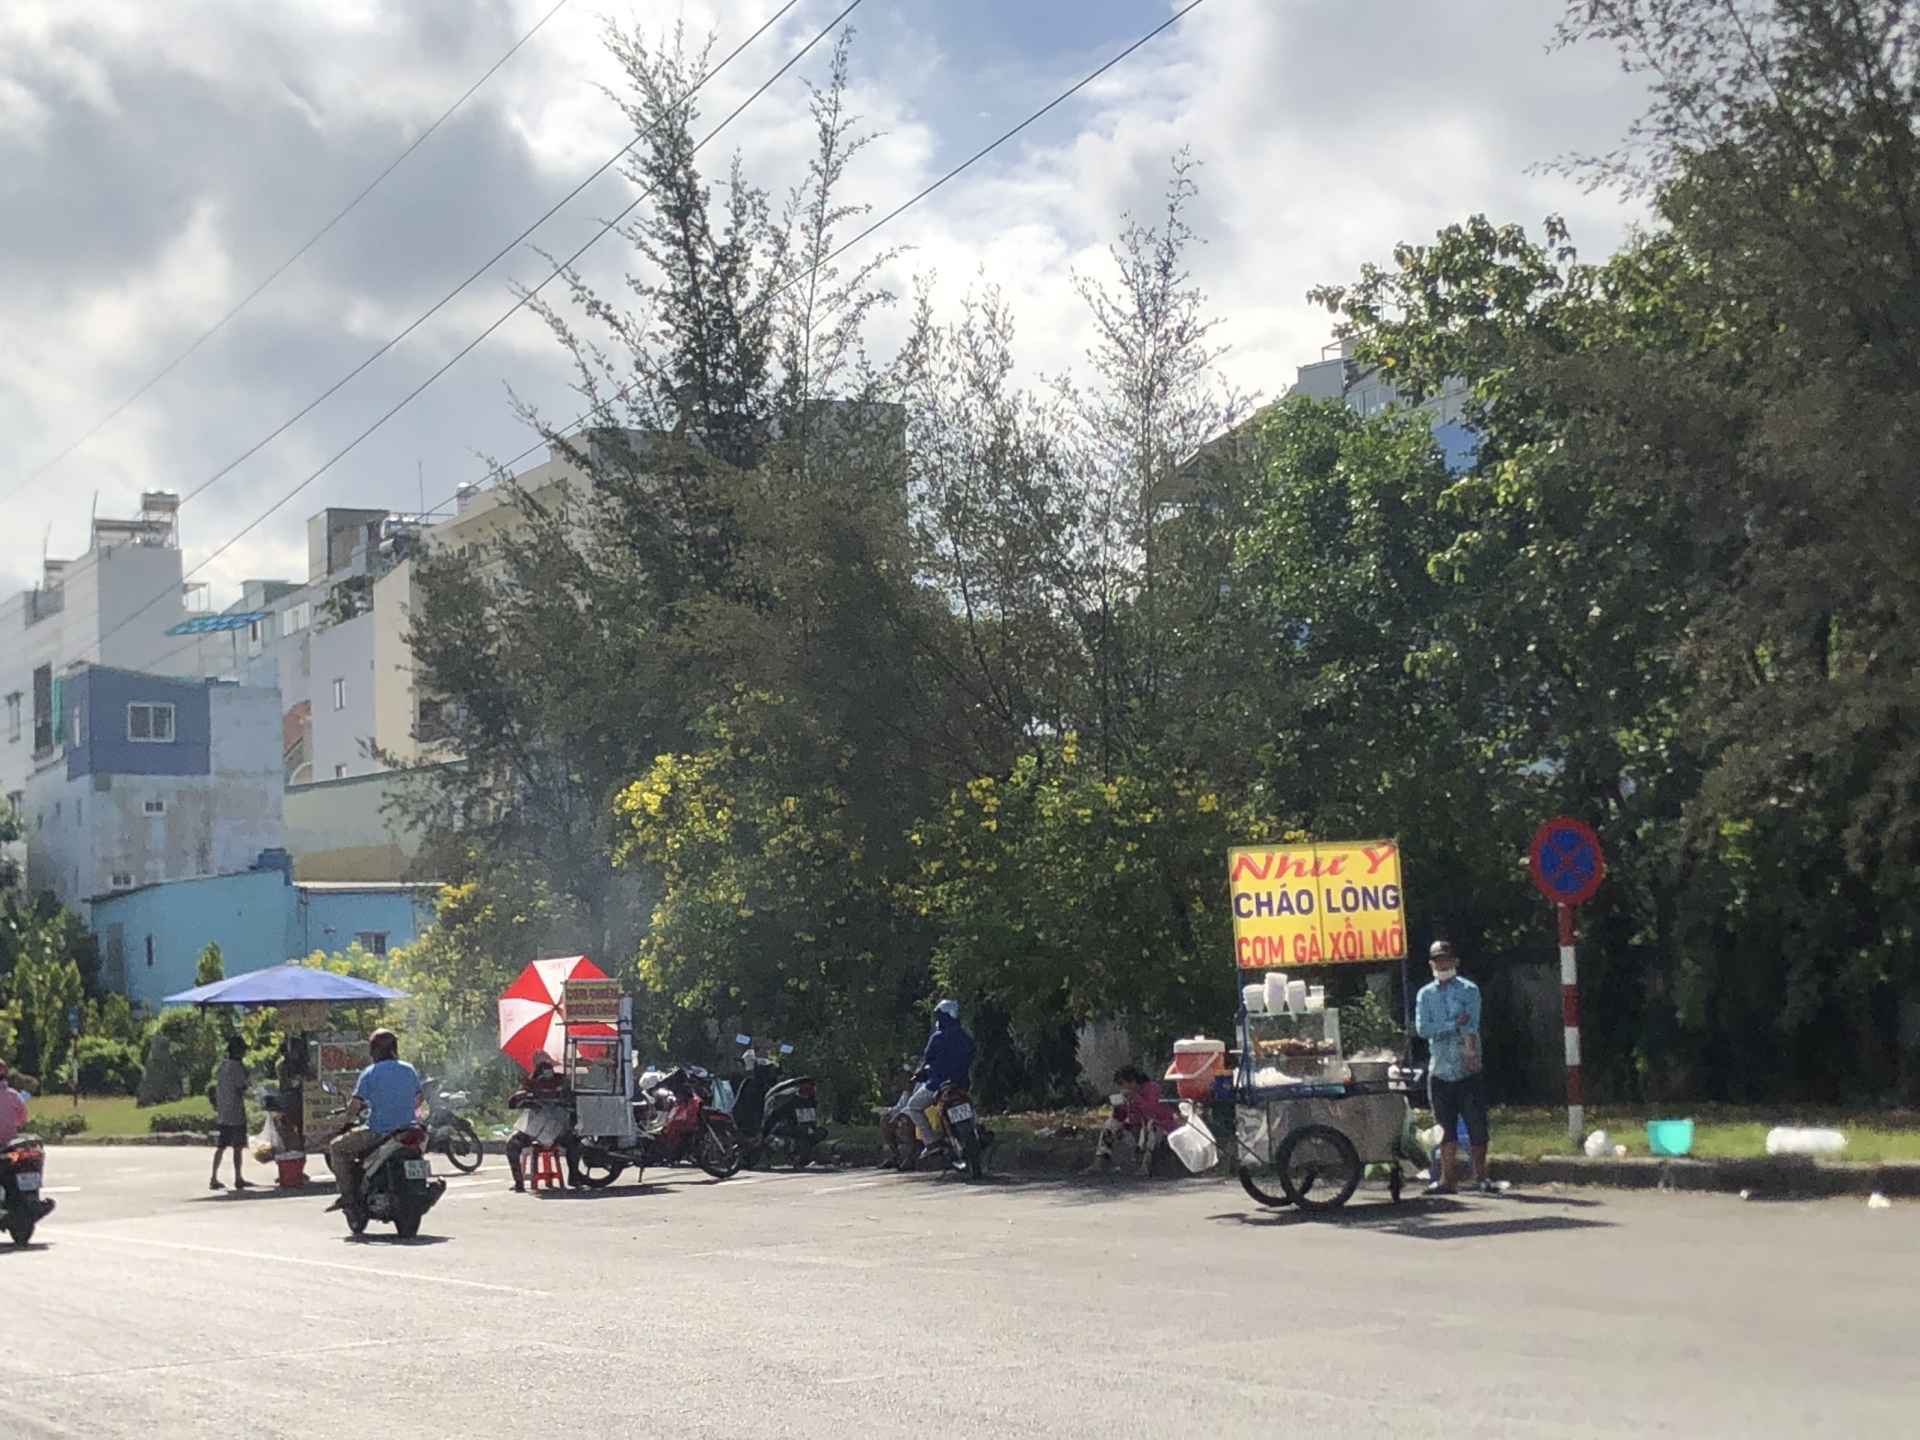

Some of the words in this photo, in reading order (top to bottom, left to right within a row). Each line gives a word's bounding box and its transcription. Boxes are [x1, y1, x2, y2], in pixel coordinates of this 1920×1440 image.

[1234, 883, 1315, 919] CHÁO
[1325, 879, 1401, 914] LÒNG
[1237, 935, 1285, 967] CƠM
[1293, 925, 1323, 963] GÀ
